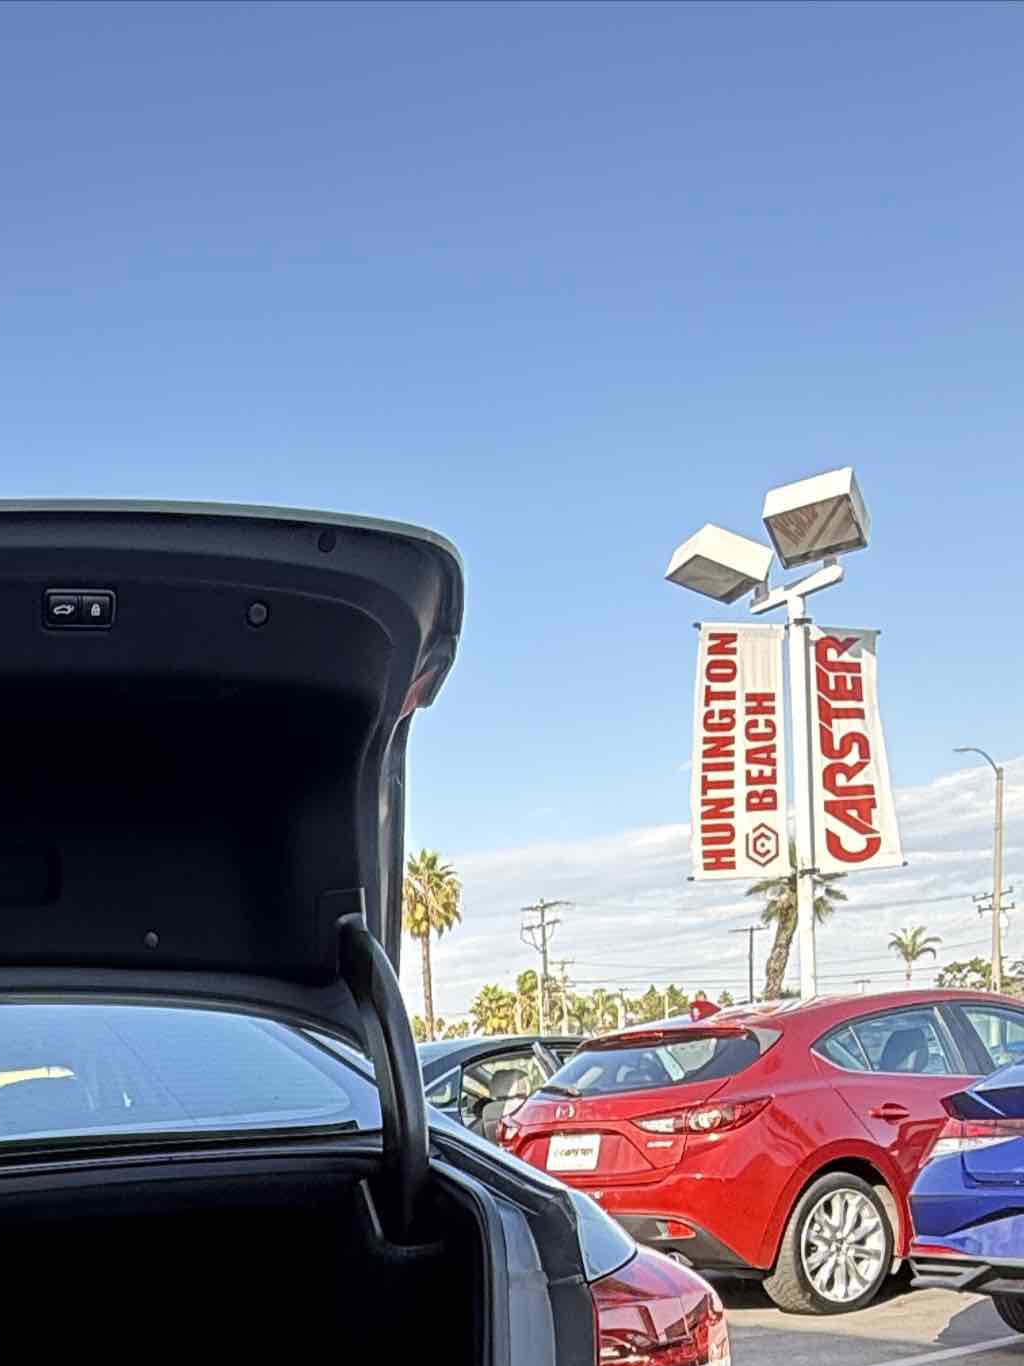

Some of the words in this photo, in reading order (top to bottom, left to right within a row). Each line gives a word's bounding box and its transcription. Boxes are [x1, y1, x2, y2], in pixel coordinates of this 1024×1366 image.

[701, 633, 738, 870] HUNTINGTON
[745, 692, 778, 811] BEACH
[815, 635, 882, 862] CARSTER
